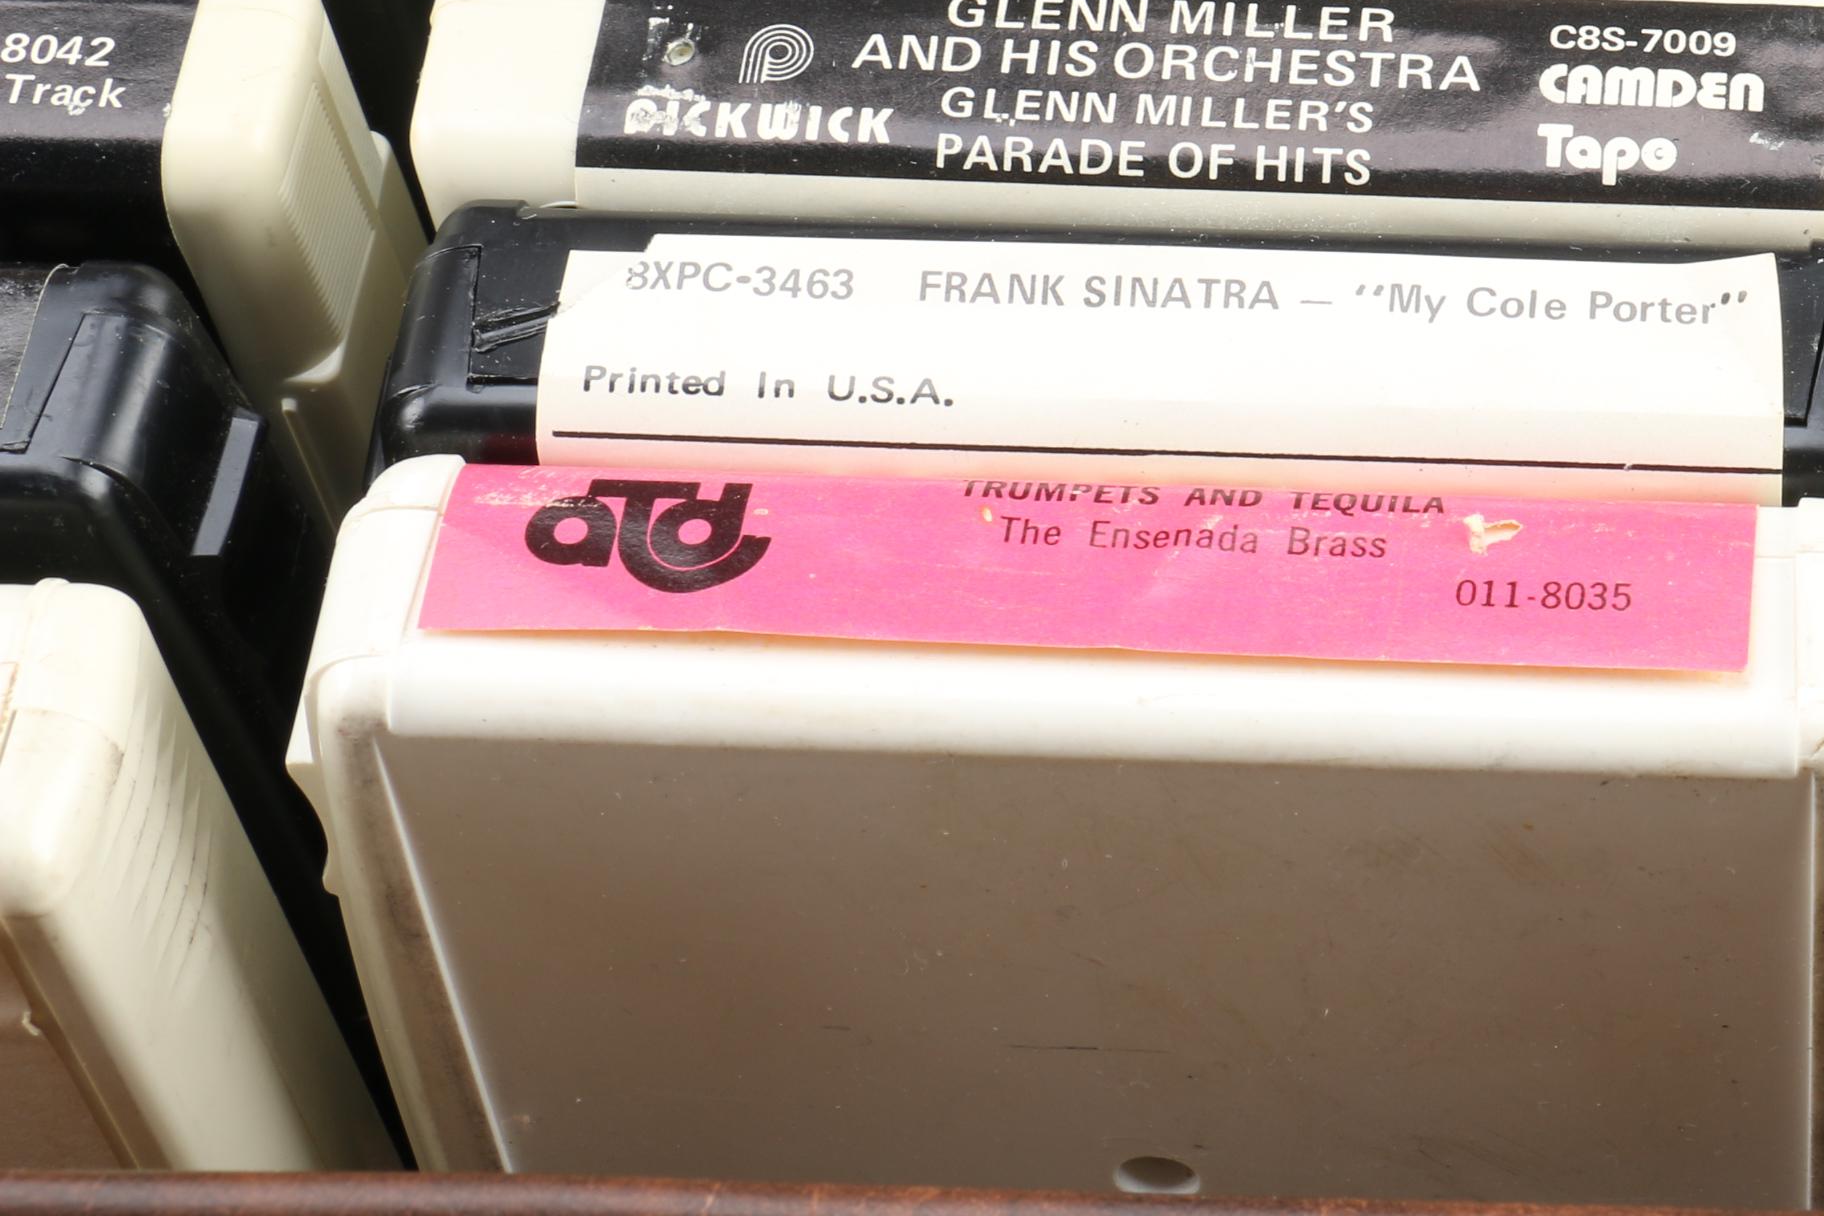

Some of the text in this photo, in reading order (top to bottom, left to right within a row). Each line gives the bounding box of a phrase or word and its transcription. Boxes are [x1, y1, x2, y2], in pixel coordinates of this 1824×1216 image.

[1170, 0, 1394, 42] MILLER
[1550, 25, 1736, 56] C8S-7009
[0, 33, 115, 66] 8042
[852, 34, 1480, 91] AND HIS ORCHESTRA
[5, 74, 126, 108] Track
[1539, 64, 1764, 111] CAMDEN
[624, 98, 895, 145] PICKWICK
[941, 87, 1373, 133] GLENN MILLER'S
[935, 132, 1371, 185] PARADE OF HITS
[1537, 123, 1677, 185] Tape
[920, 271, 1064, 306] FRANK
[1083, 275, 1278, 309] SINATRA
[1467, 287, 1566, 320] Cole
[584, 366, 953, 407] Printed In U.S.A.
[964, 481, 1444, 517] TRUMPETS AND TEQUILA
[1001, 516, 1386, 558] The Ensenada Brass
[1456, 580, 1631, 611] 011-8035
